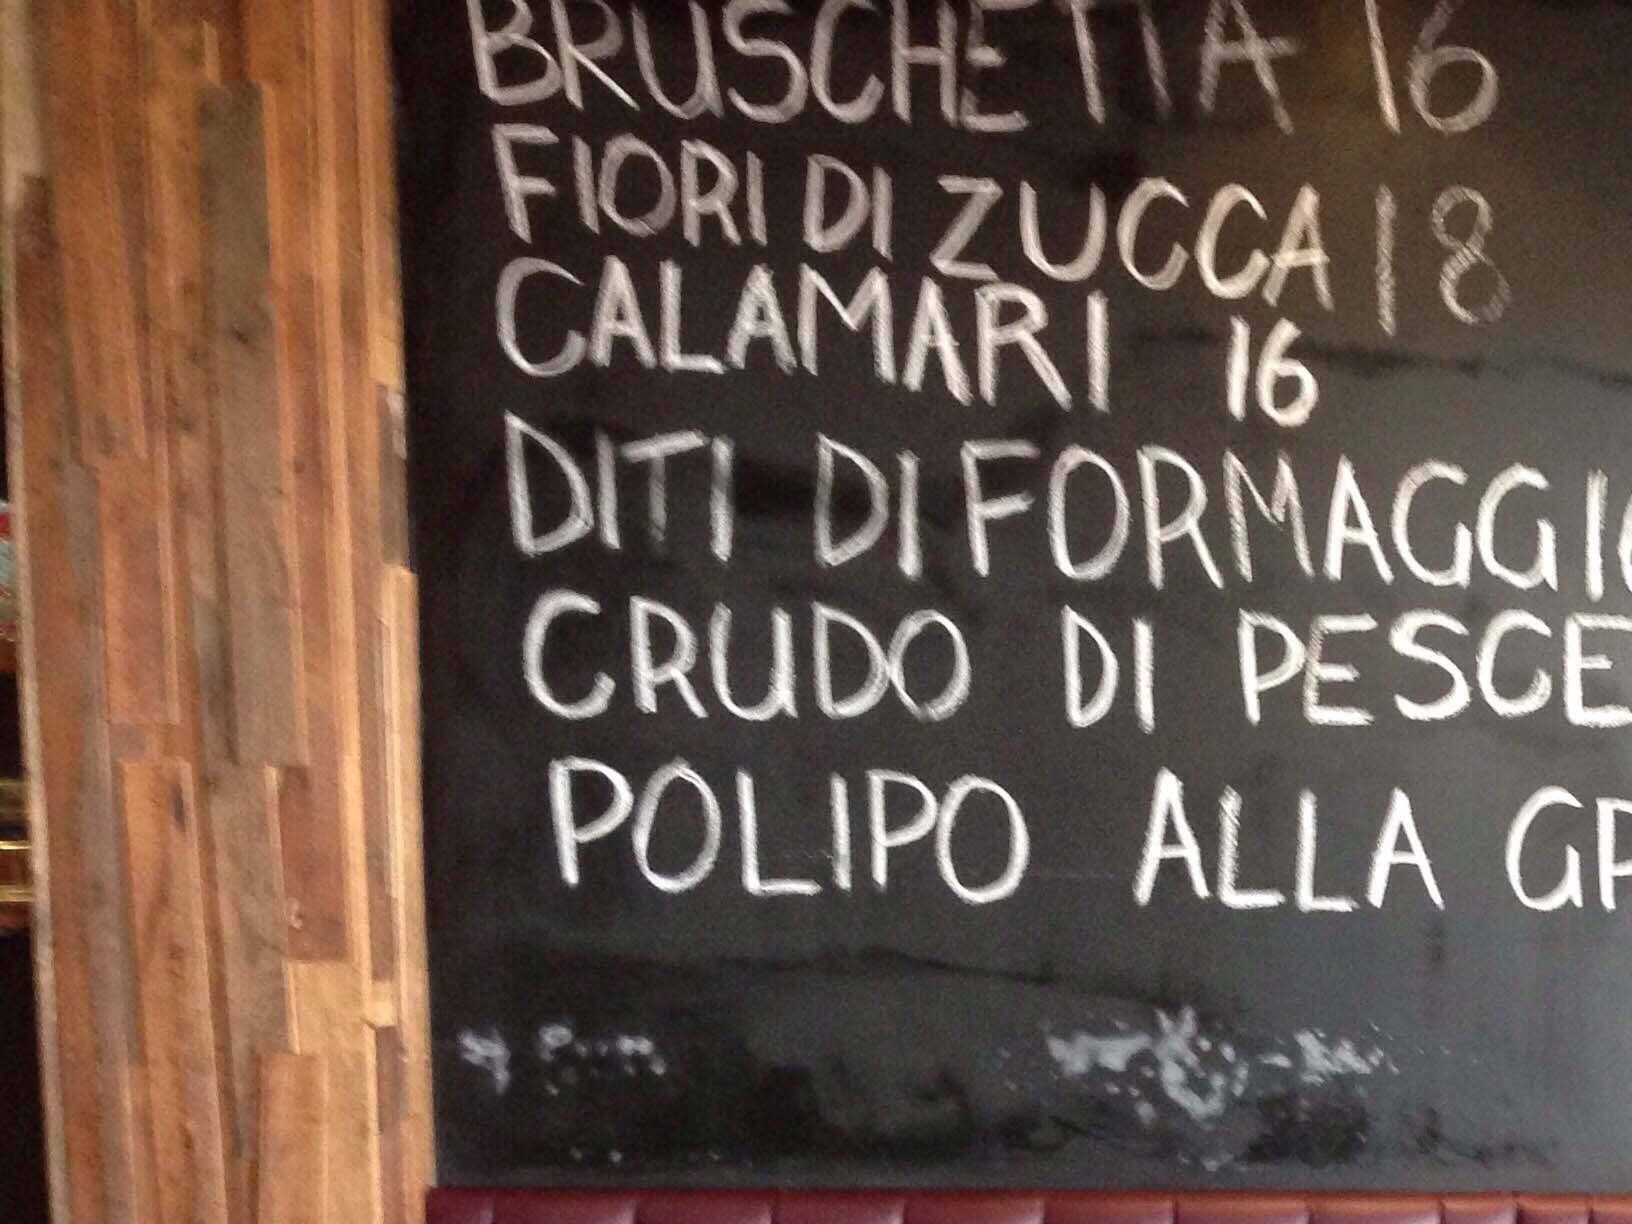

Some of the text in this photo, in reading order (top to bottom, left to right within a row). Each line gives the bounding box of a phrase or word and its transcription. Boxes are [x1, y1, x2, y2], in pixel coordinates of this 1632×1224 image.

[469, 0, 1499, 135] BRUSCHETTA 16
[493, 123, 1511, 336] FIORI DI ZUCCA 18
[495, 253, 1319, 428] CALAMARI 16
[504, 410, 733, 563] DITI
[815, 431, 922, 580] DI
[522, 588, 972, 721] CRUDO
[1062, 604, 1155, 733] DI
[548, 756, 1029, 905] POLIPO
[1134, 766, 1445, 913] ALLA
